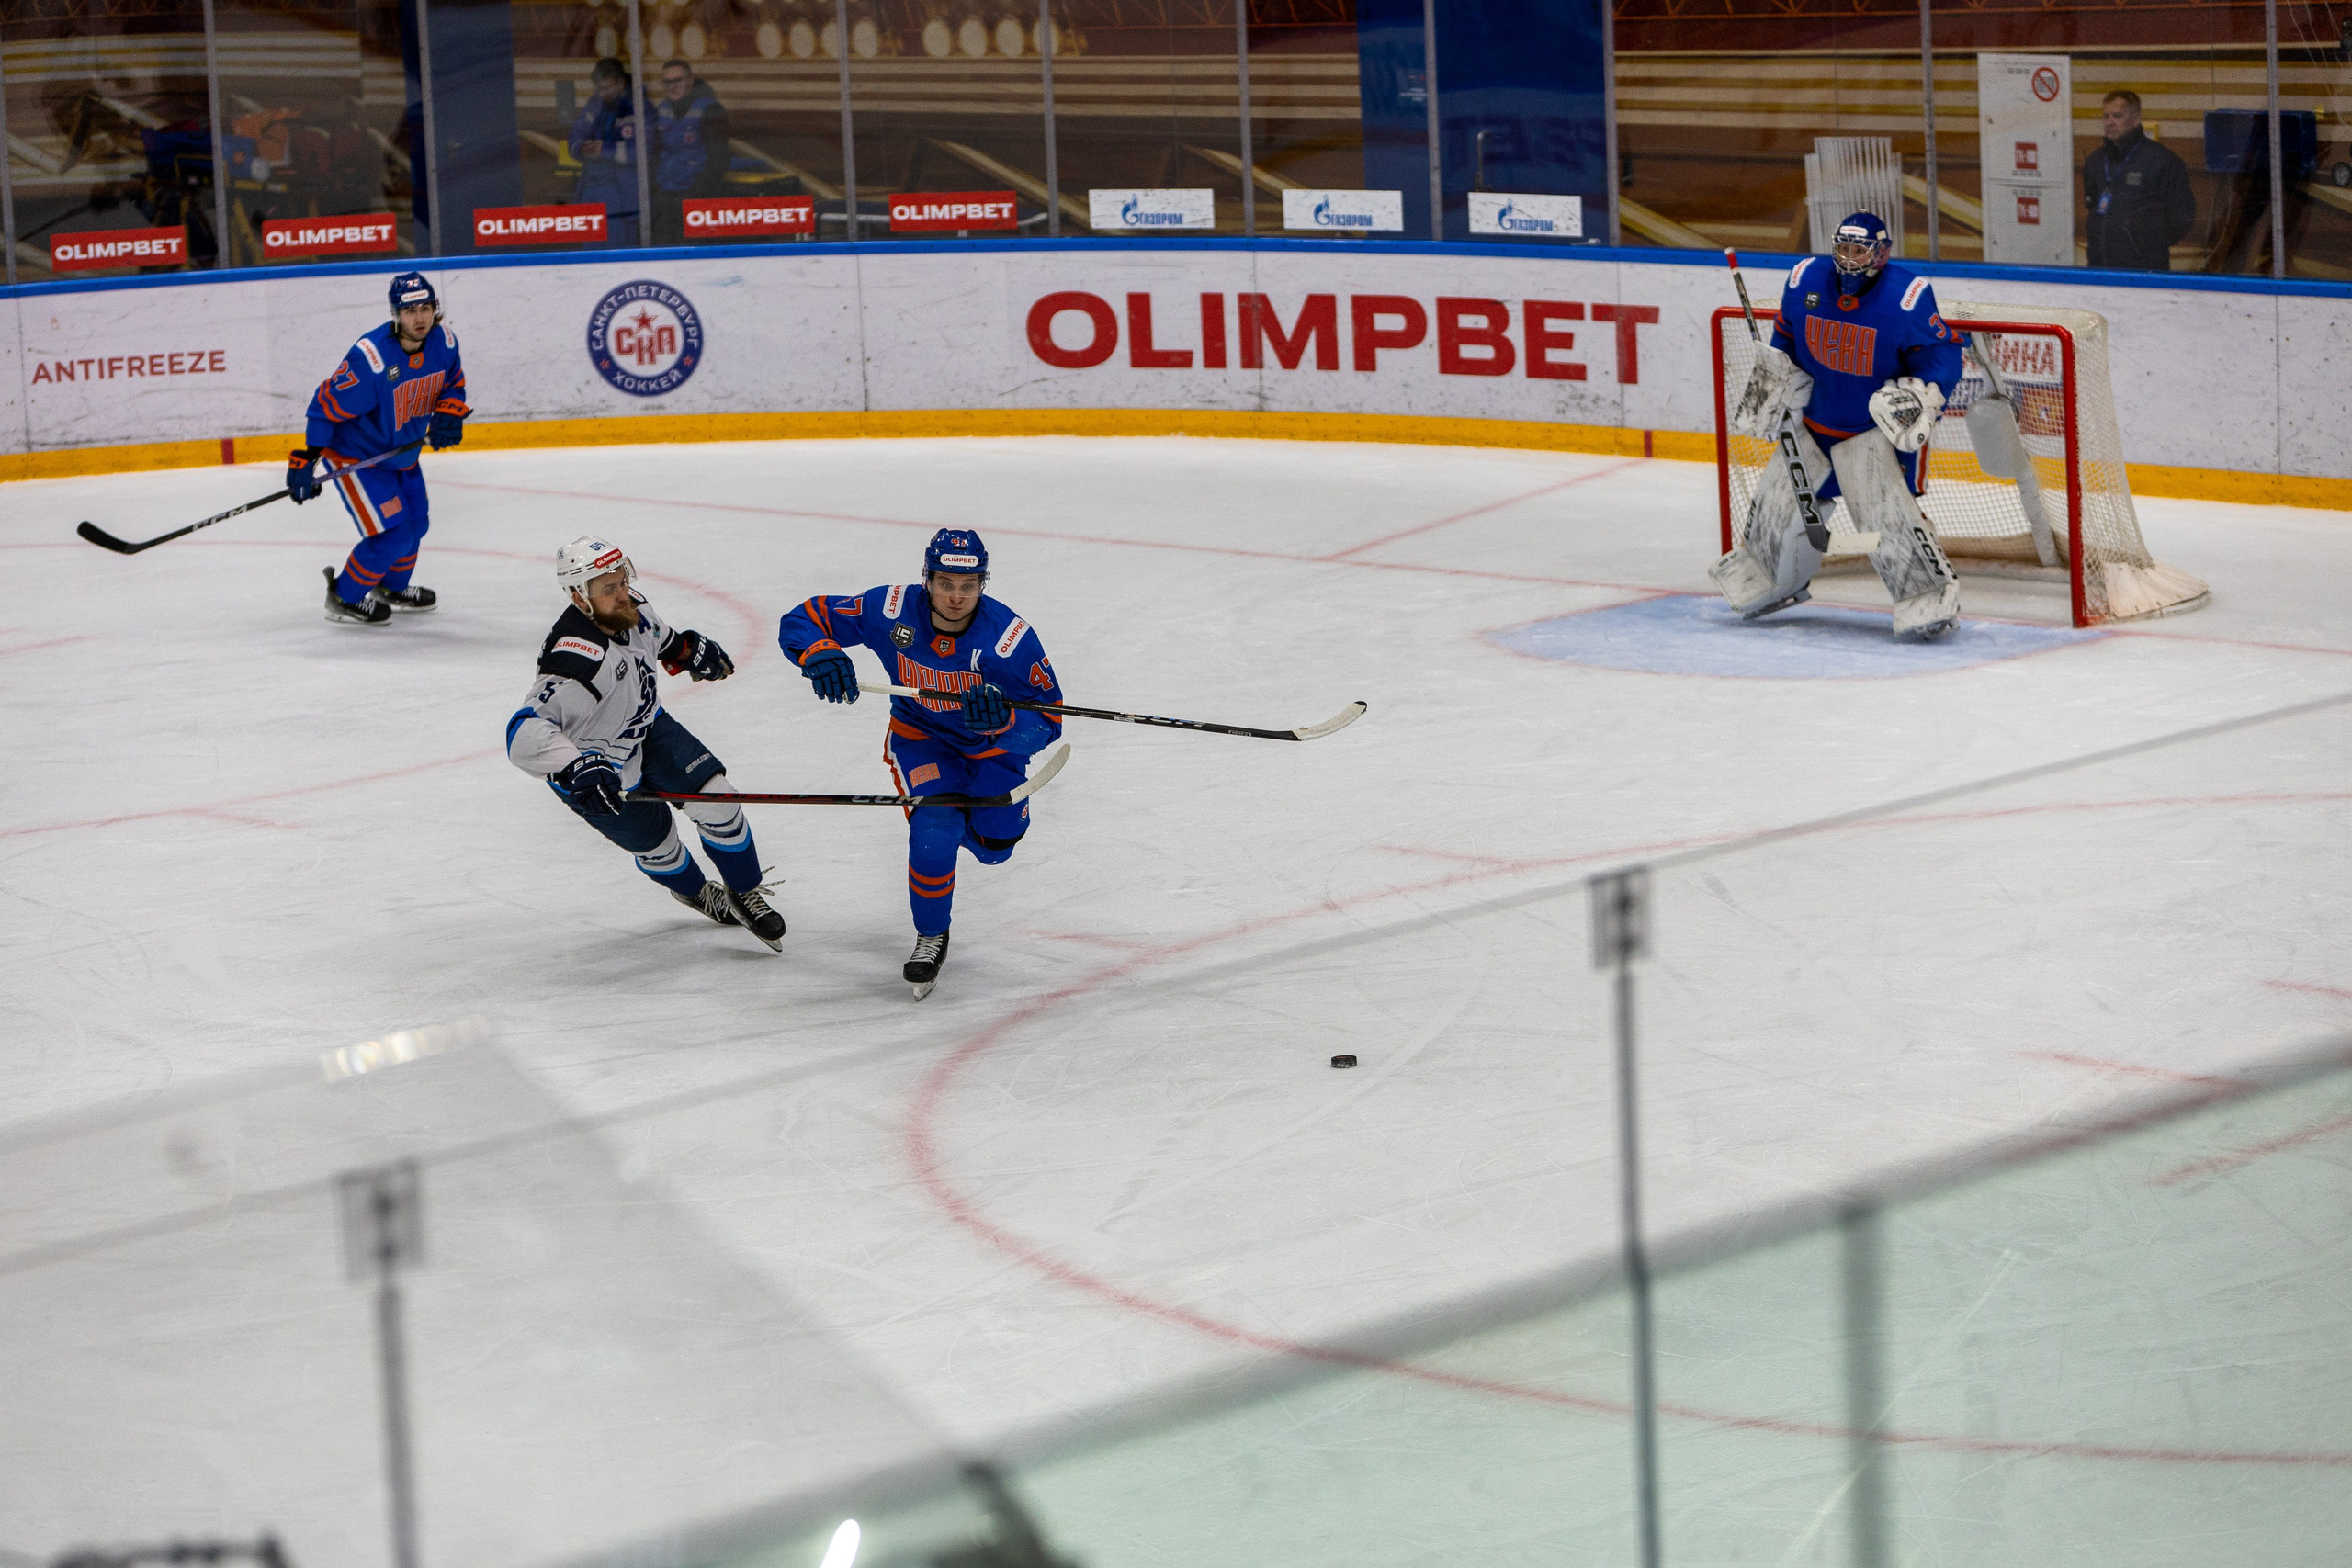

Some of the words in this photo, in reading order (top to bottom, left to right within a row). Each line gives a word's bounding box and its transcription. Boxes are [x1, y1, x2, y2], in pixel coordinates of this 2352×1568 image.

[686, 207, 810, 228] OLIMPBET
[892, 202, 1012, 220] OLIMPBET
[1139, 212, 1183, 225] ГАЗПРОМ
[1330, 214, 1373, 226] ГАЗПРОМ
[266, 223, 393, 247] OLIMPBET
[477, 214, 604, 235] OLIMPBET
[1513, 219, 1554, 231] ГАЗПРОМ
[55, 237, 182, 262] OLIMPBET
[591, 284, 699, 351] САНКТ-ПЕТЕРБУРГ
[614, 324, 676, 366] СКА
[1025, 290, 1660, 385] OLIMPBET
[31, 349, 227, 385] ANTIFREEZE
[332, 359, 360, 391] 27
[613, 368, 683, 392] ХОККЕЙ
[1780, 430, 1820, 525] CCM
[1913, 526, 1946, 576] CCM
[851, 795, 924, 806] CCM
